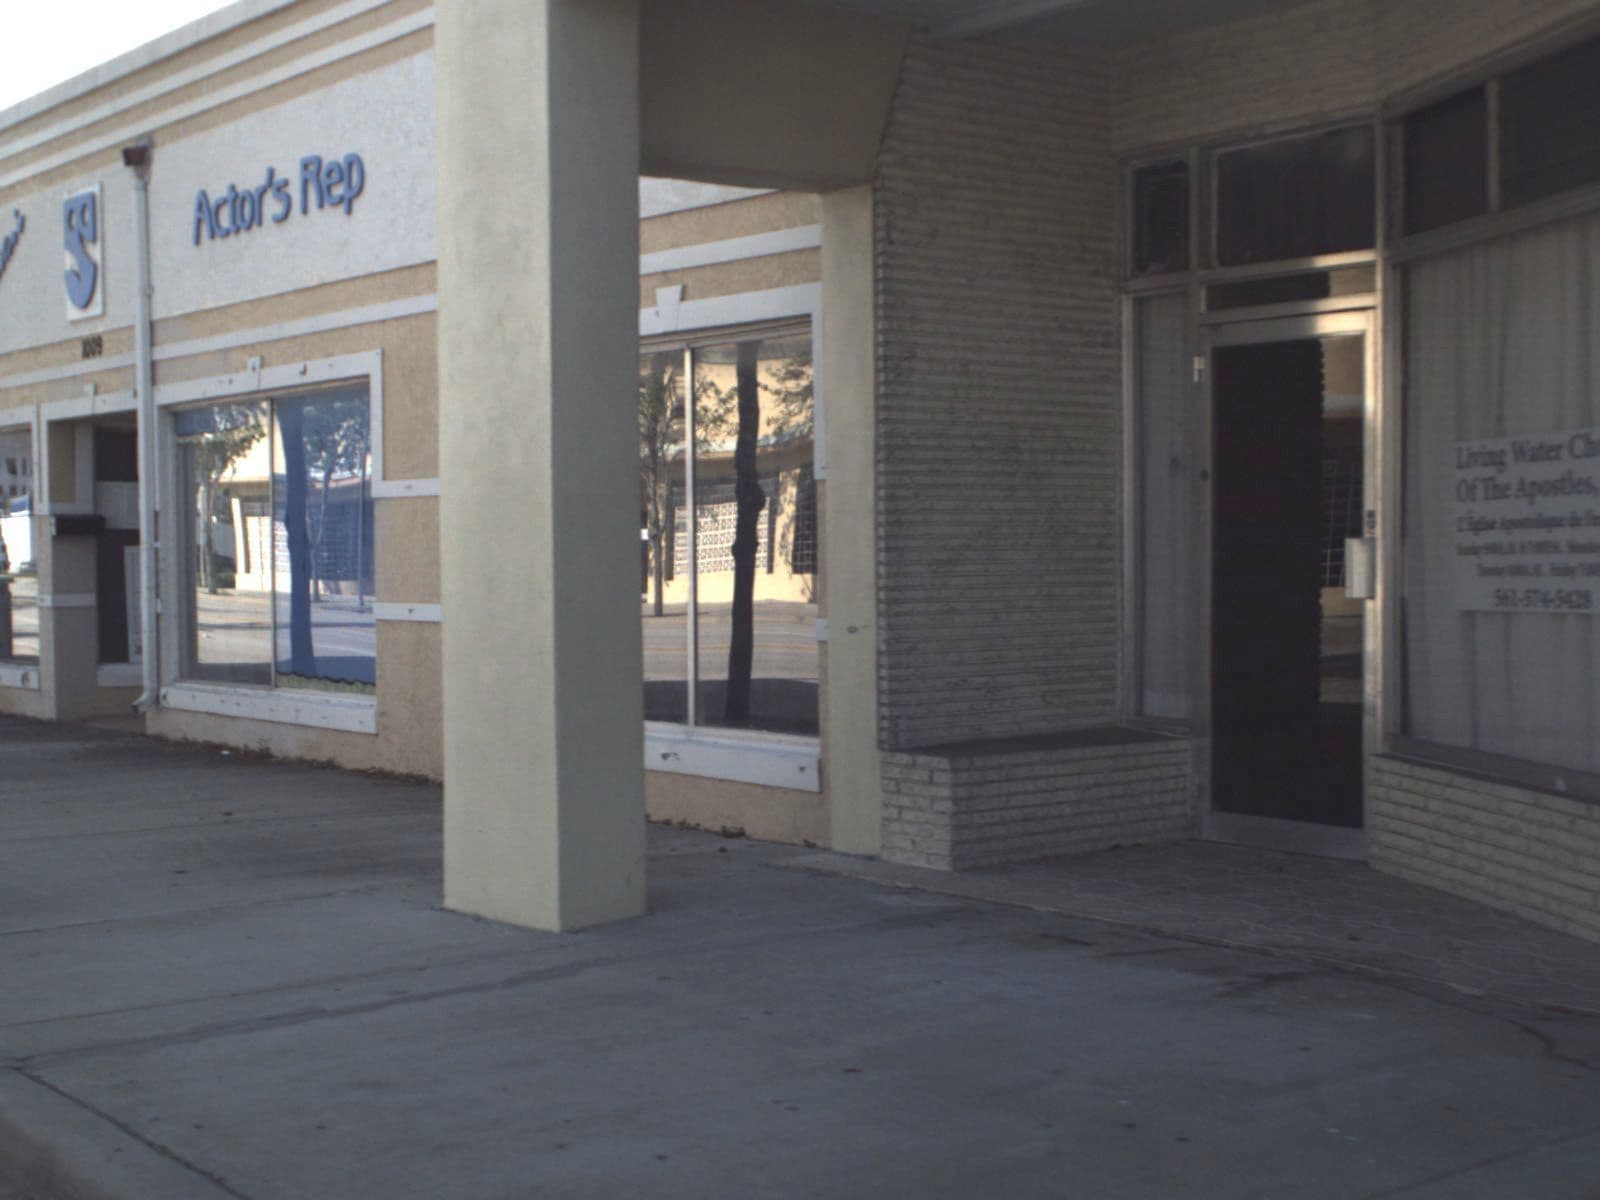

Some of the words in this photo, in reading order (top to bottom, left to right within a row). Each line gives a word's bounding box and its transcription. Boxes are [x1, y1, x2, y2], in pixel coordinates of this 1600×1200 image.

[193, 166, 293, 246] Actor's
[300, 152, 365, 216] Rep
[1455, 445, 1506, 473] Living
[1511, 440, 1564, 464] Water
[1456, 477, 1477, 503] Of
[1479, 476, 1512, 502] The
